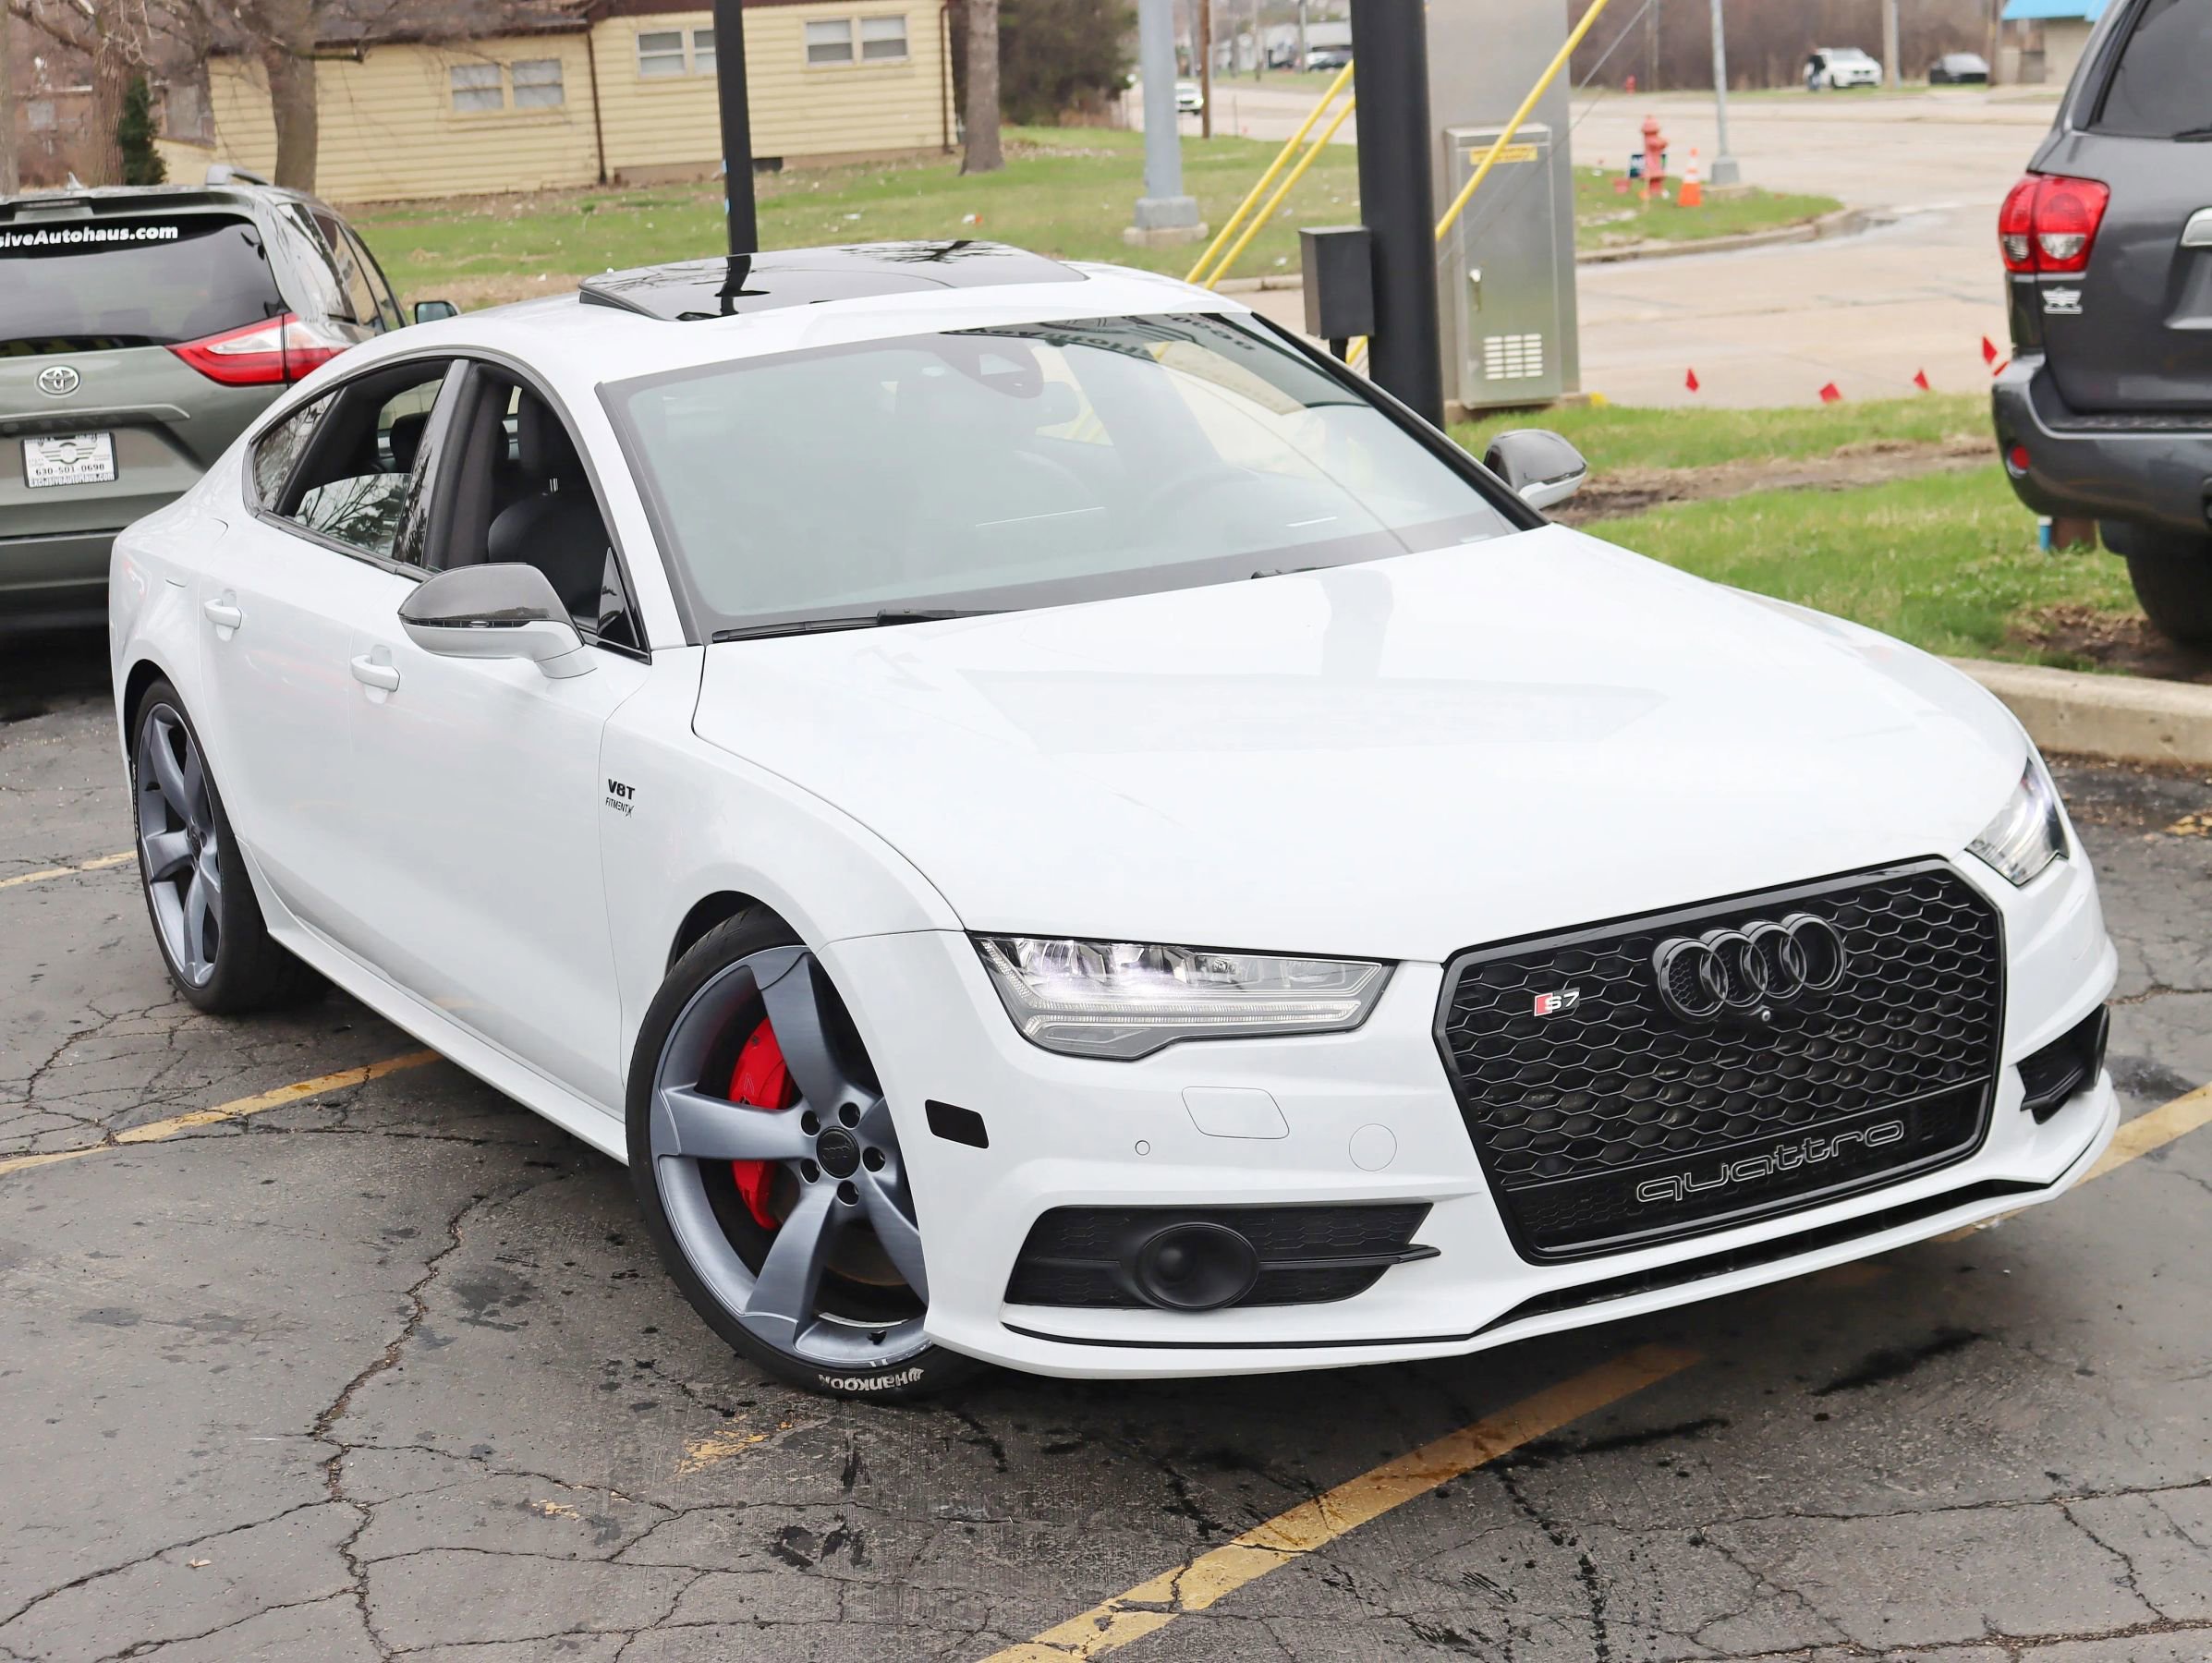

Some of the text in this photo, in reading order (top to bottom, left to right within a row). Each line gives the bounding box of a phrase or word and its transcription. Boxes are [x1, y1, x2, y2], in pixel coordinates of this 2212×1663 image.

[608, 778, 636, 800] V8T
[1544, 990, 1580, 1011] S7
[1636, 1120, 1904, 1202] quattro
